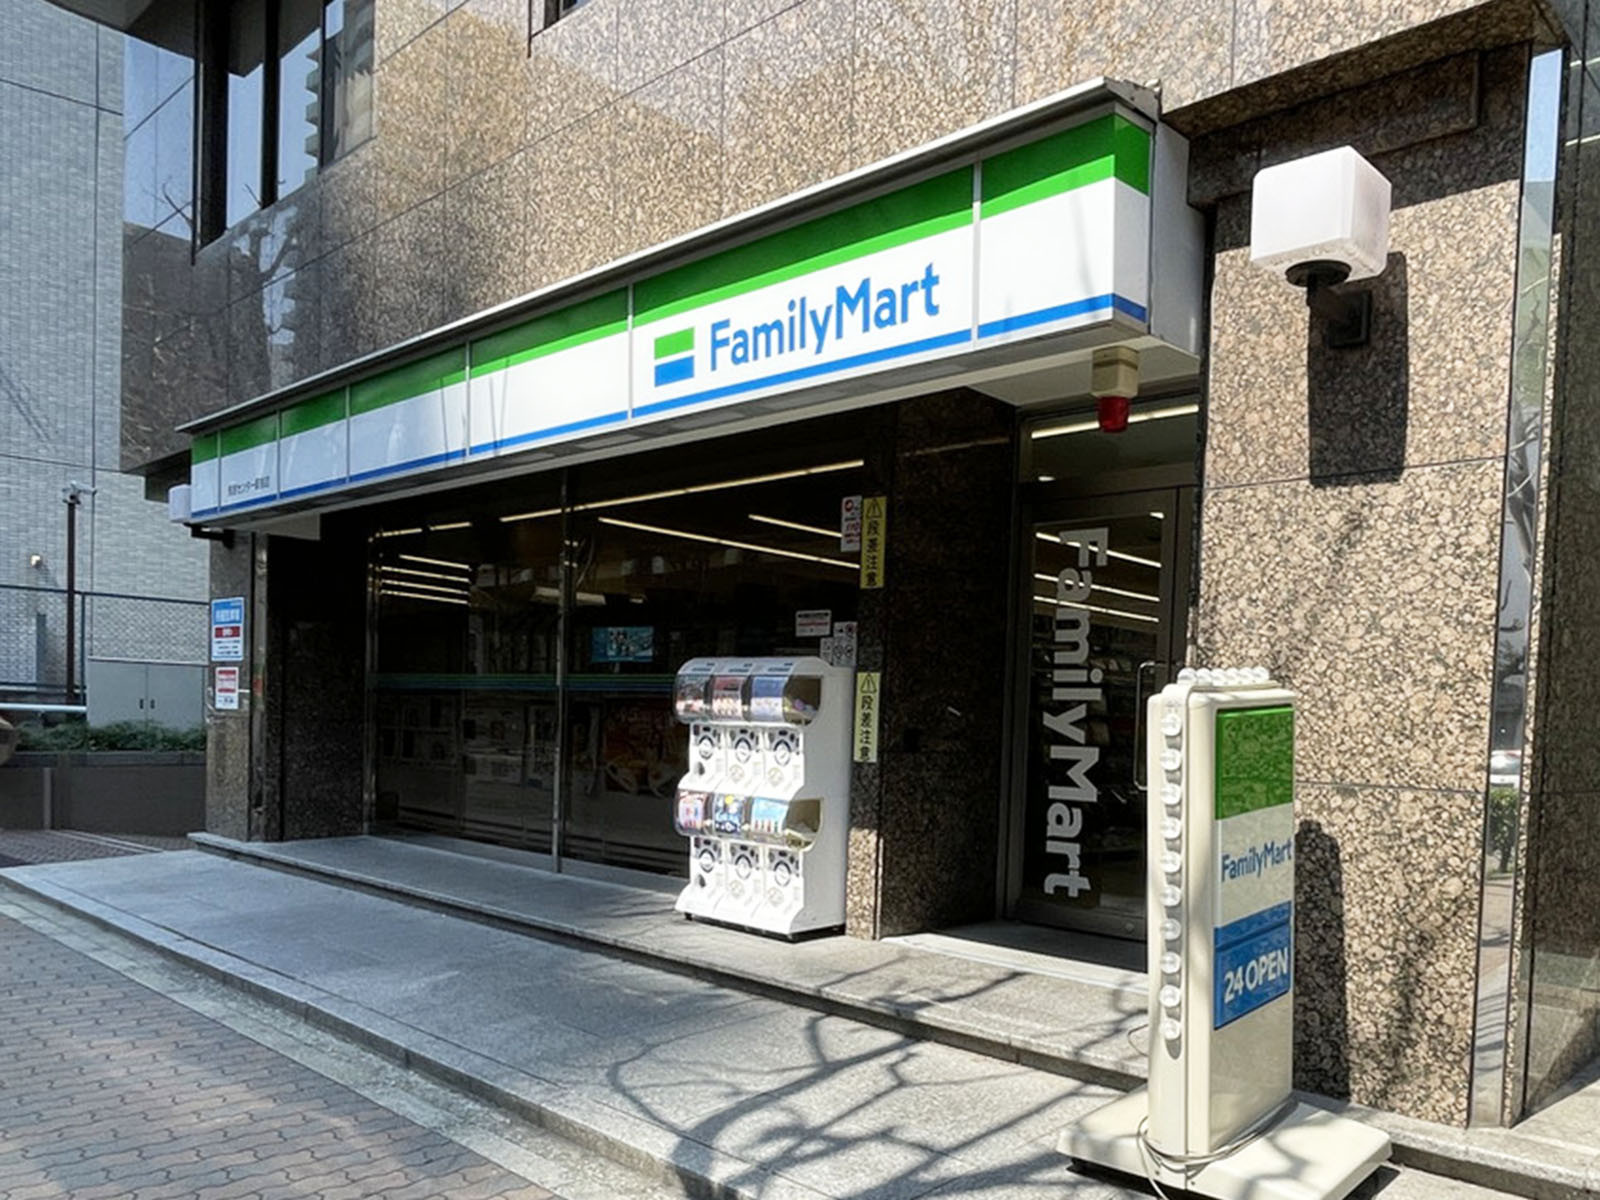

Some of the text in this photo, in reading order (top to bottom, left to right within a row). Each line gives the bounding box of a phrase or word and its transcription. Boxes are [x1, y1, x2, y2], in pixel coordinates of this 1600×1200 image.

[711, 263, 940, 371] FamilyMart
[866, 520, 880, 587] 段差注意
[860, 695, 874, 761] 段差注意
[1043, 527, 1109, 898] FamilyMart
[1221, 838, 1292, 882] FamilyMart
[1224, 947, 1289, 1004] 24 OPEN
